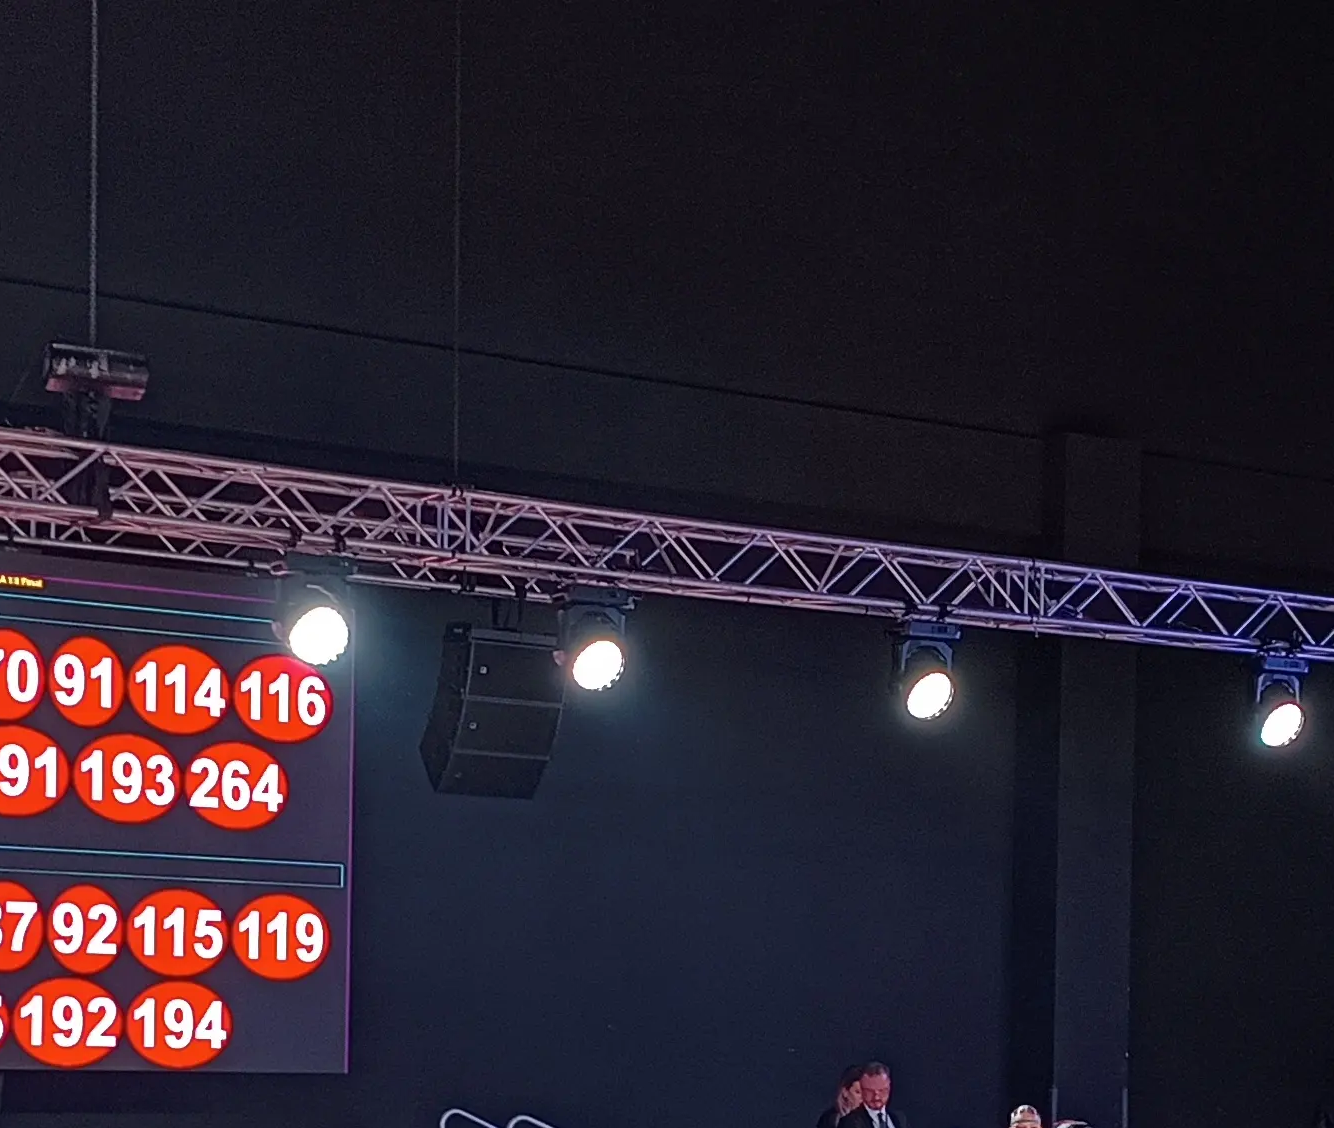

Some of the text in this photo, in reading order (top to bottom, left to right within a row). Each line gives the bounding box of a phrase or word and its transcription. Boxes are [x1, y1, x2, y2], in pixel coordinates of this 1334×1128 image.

[53, 653, 112, 709] 91
[135, 661, 226, 718] 114
[240, 670, 326, 726] 116
[80, 749, 175, 806] 193
[189, 757, 284, 813] 264
[52, 902, 118, 955] 92
[133, 905, 224, 959] 115
[238, 910, 324, 963] 119
[20, 995, 117, 1048] 192
[133, 998, 227, 1049] 194
